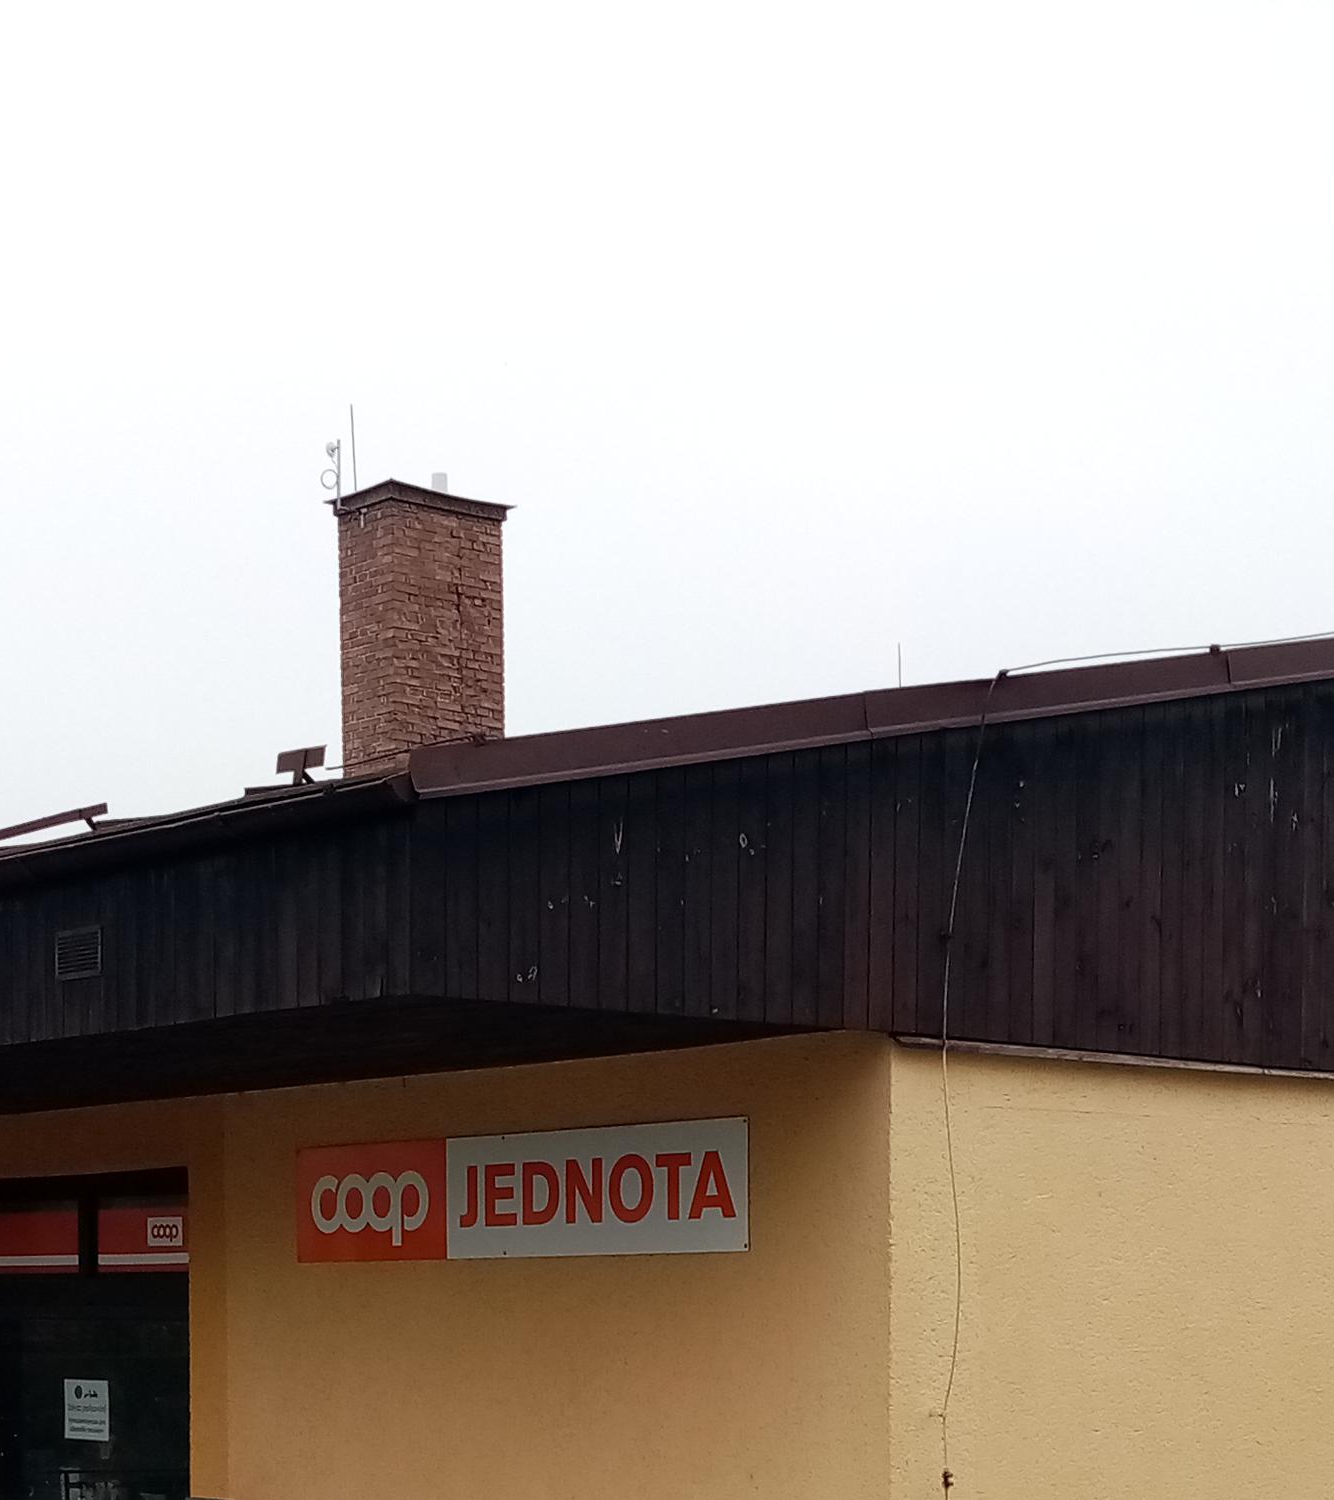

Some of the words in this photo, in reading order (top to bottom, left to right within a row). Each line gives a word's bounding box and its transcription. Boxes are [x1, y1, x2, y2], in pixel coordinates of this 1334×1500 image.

[311, 1170, 429, 1246] coop
[459, 1150, 737, 1228] JEDNOTA
[151, 1223, 178, 1242] coop
